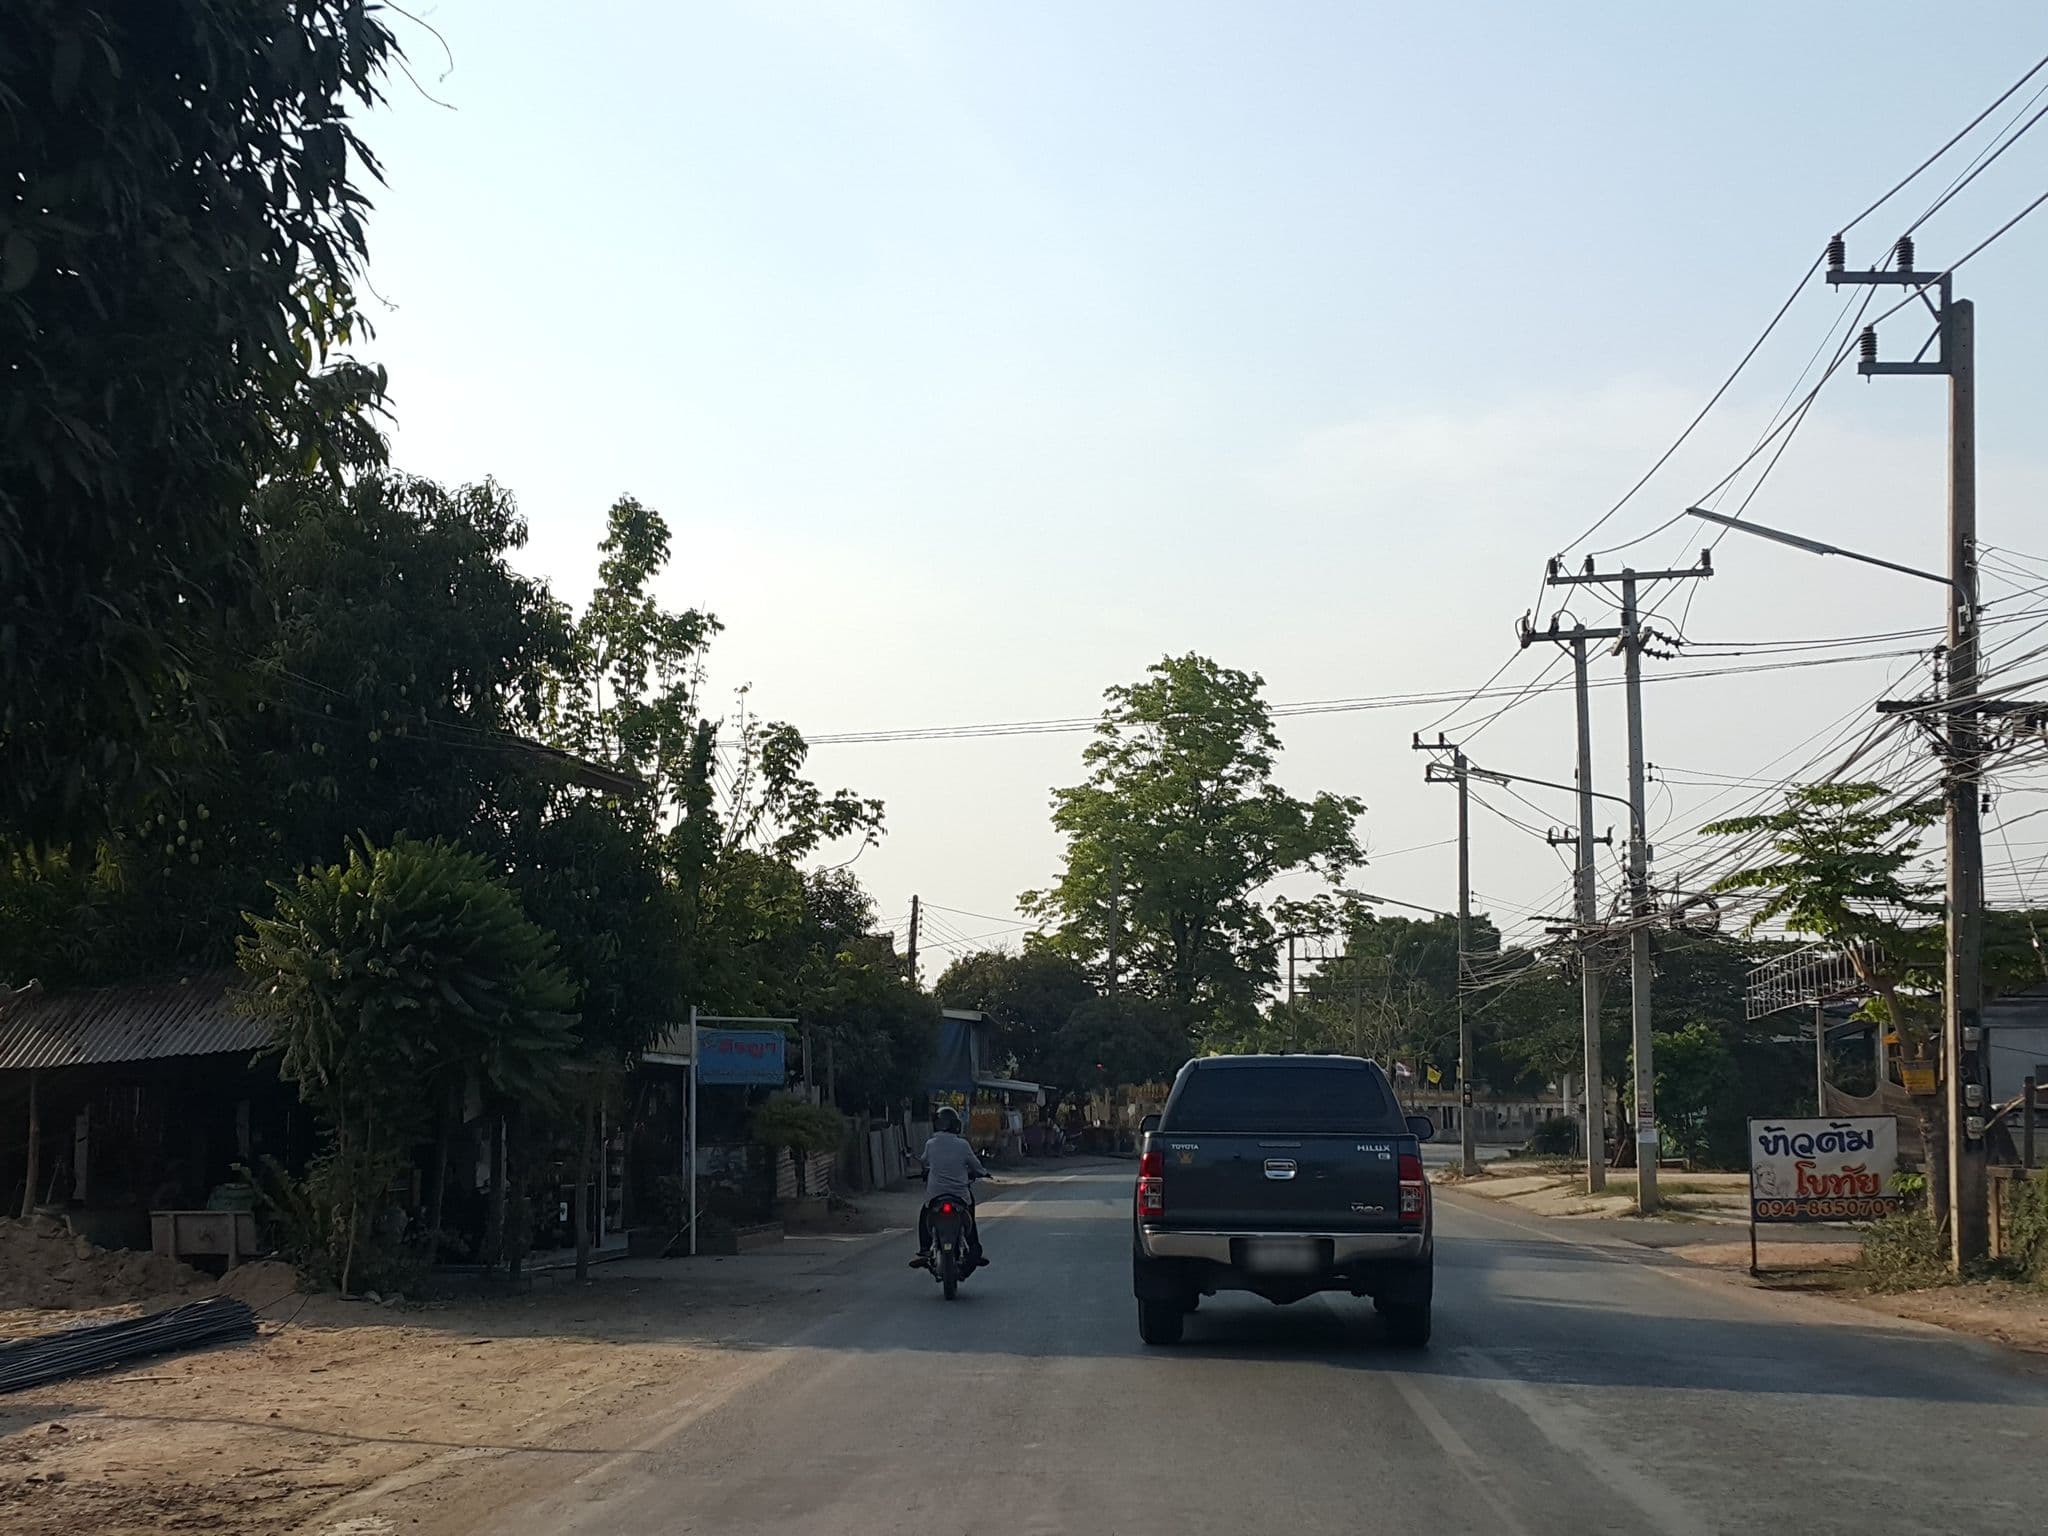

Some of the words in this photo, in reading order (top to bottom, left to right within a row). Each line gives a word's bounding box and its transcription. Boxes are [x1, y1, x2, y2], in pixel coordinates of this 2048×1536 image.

[1357, 1144, 1391, 1152] HILUX
[1758, 1122, 1874, 1159] ข้าวต้ม
